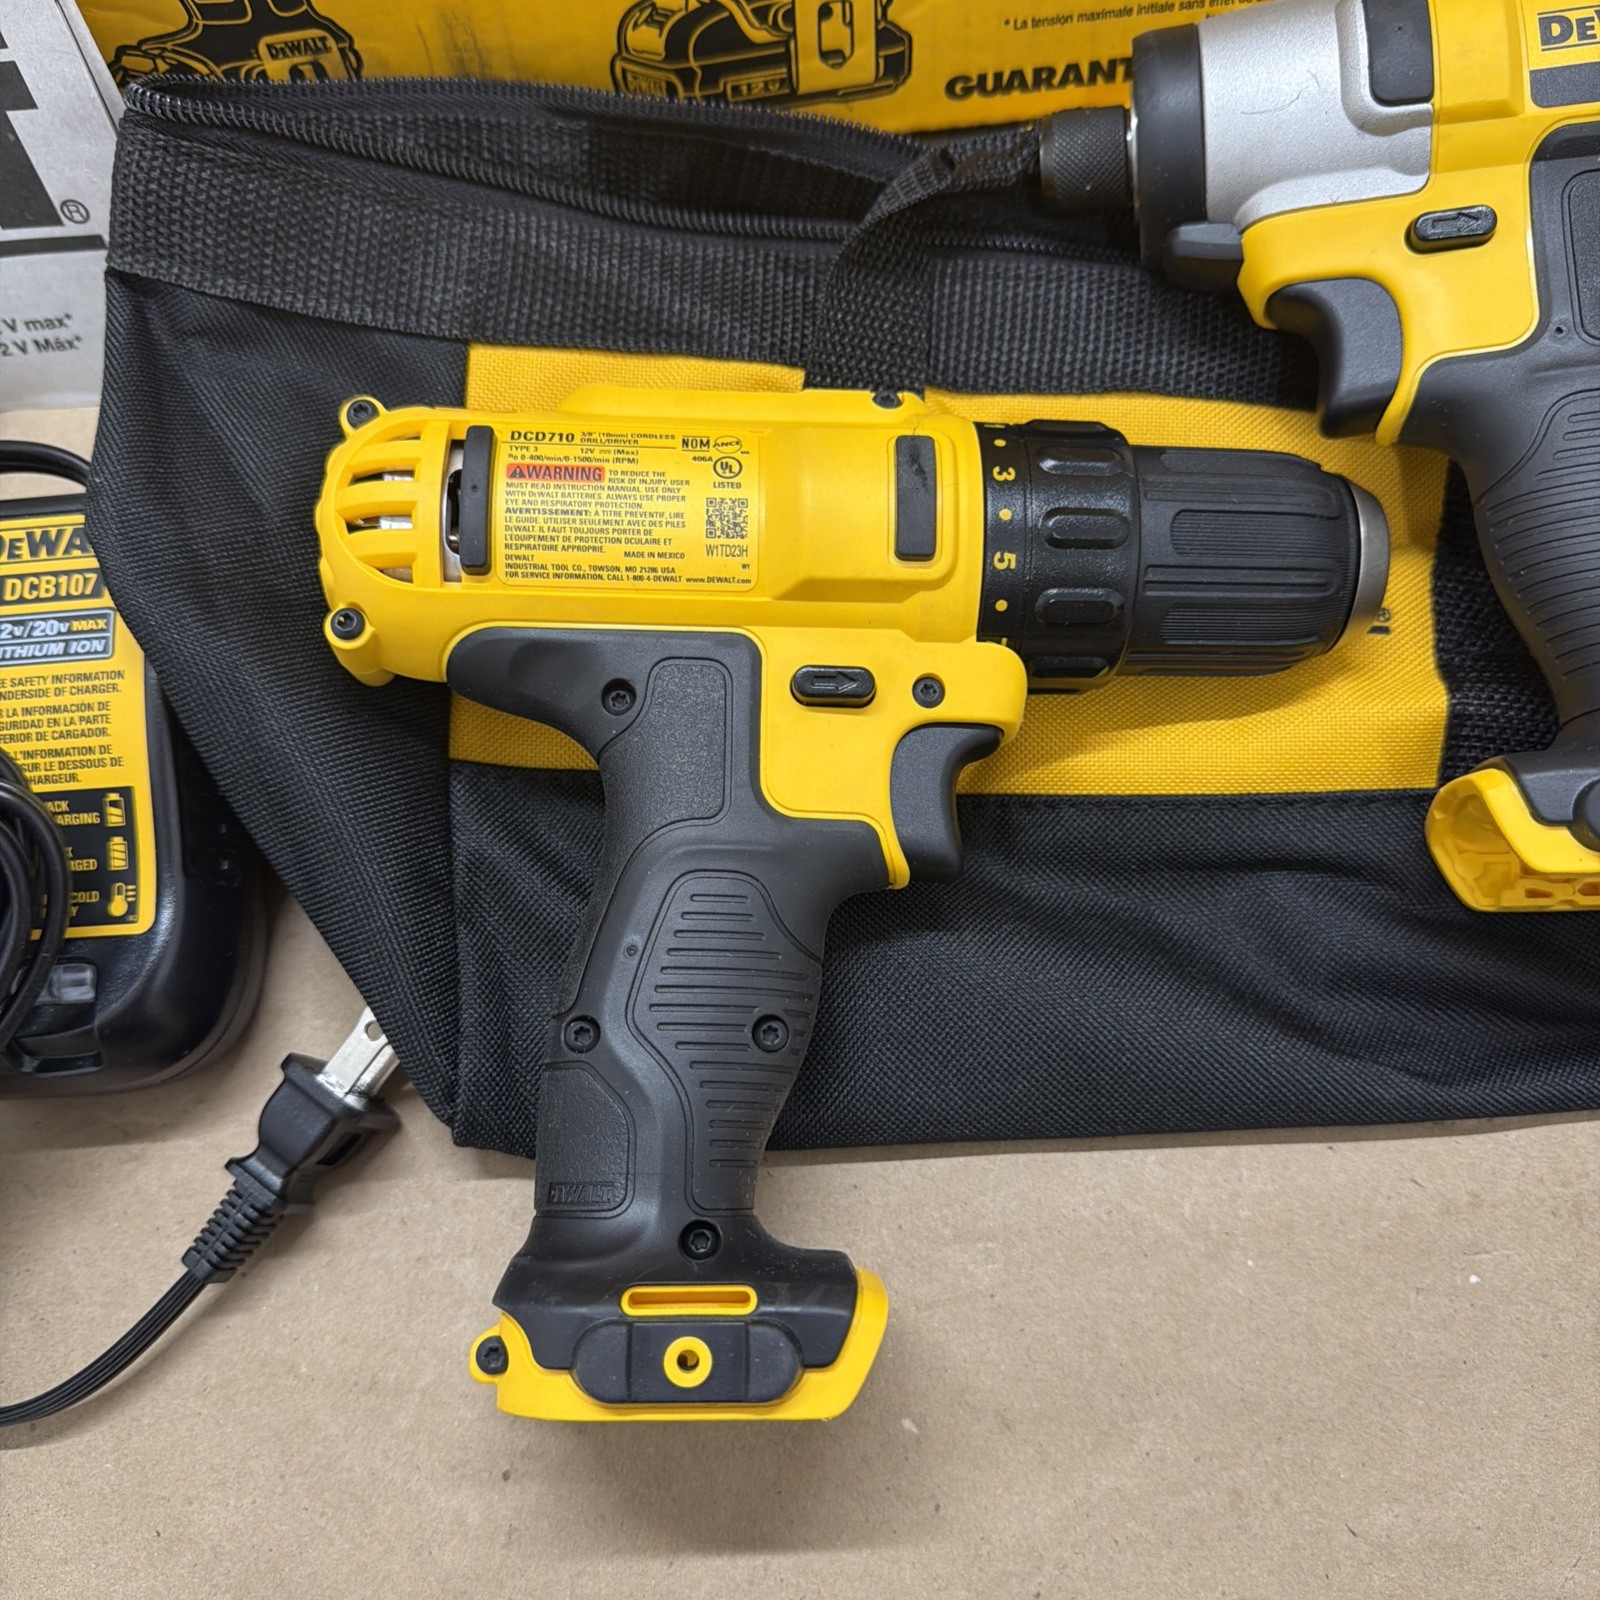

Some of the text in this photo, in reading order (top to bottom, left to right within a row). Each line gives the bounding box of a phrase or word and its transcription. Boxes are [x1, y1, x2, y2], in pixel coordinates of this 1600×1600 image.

[1014, 19, 1027, 30] La
[1032, 14, 1073, 28] tension
[1077, 6, 1133, 22] maximale
[1538, 10, 1600, 46] DE
[511, 431, 575, 442] DCD710
[682, 438, 710, 449] NOM
[526, 466, 602, 481] WARNING
[992, 466, 1016, 482] 3
[554, 483, 605, 491] INSTRUCTION
[541, 500, 592, 508] RESPIRATORY
[505, 507, 591, 516] AVERTISSEMENT:
[544, 517, 577, 525] UTILISER
[579, 518, 624, 526] SEULEMENT
[627, 519, 646, 527] AVEC
[569, 527, 609, 535] TOUJOURS
[612, 528, 641, 536] PORTER
[0, 527, 91, 560] EWA
[575, 536, 622, 544] PROTECTION
[625, 537, 660, 545] OCULAIRE
[505, 543, 559, 551] RESPIRATOIRE
[706, 545, 748, 557] W1TD23H
[993, 551, 1016, 570] 5
[4, 573, 97, 601] DCB107
[70, 619, 107, 631] MAX
[68, 640, 105, 653] ION
[10, 676, 49, 687] SAFETY
[52, 670, 125, 684] INFORMATION
[54, 688, 67, 697] OF
[6, 709, 19, 718] LA
[98, 701, 111, 711] DE
[47, 718, 60, 727] EN
[64, 717, 76, 726] LA
[79, 714, 111, 725] PARTE
[36, 731, 49, 741] DE
[99, 745, 112, 755] DE
[44, 762, 55, 771] LE
[58, 758, 107, 771] DESSOUS
[110, 757, 124, 767] DE
[28, 773, 82, 784] HARGEUR.
[46, 801, 69, 812] ACK
[56, 812, 100, 825] ARGING
[68, 859, 97, 871] RGED
[70, 891, 99, 903] COLD
